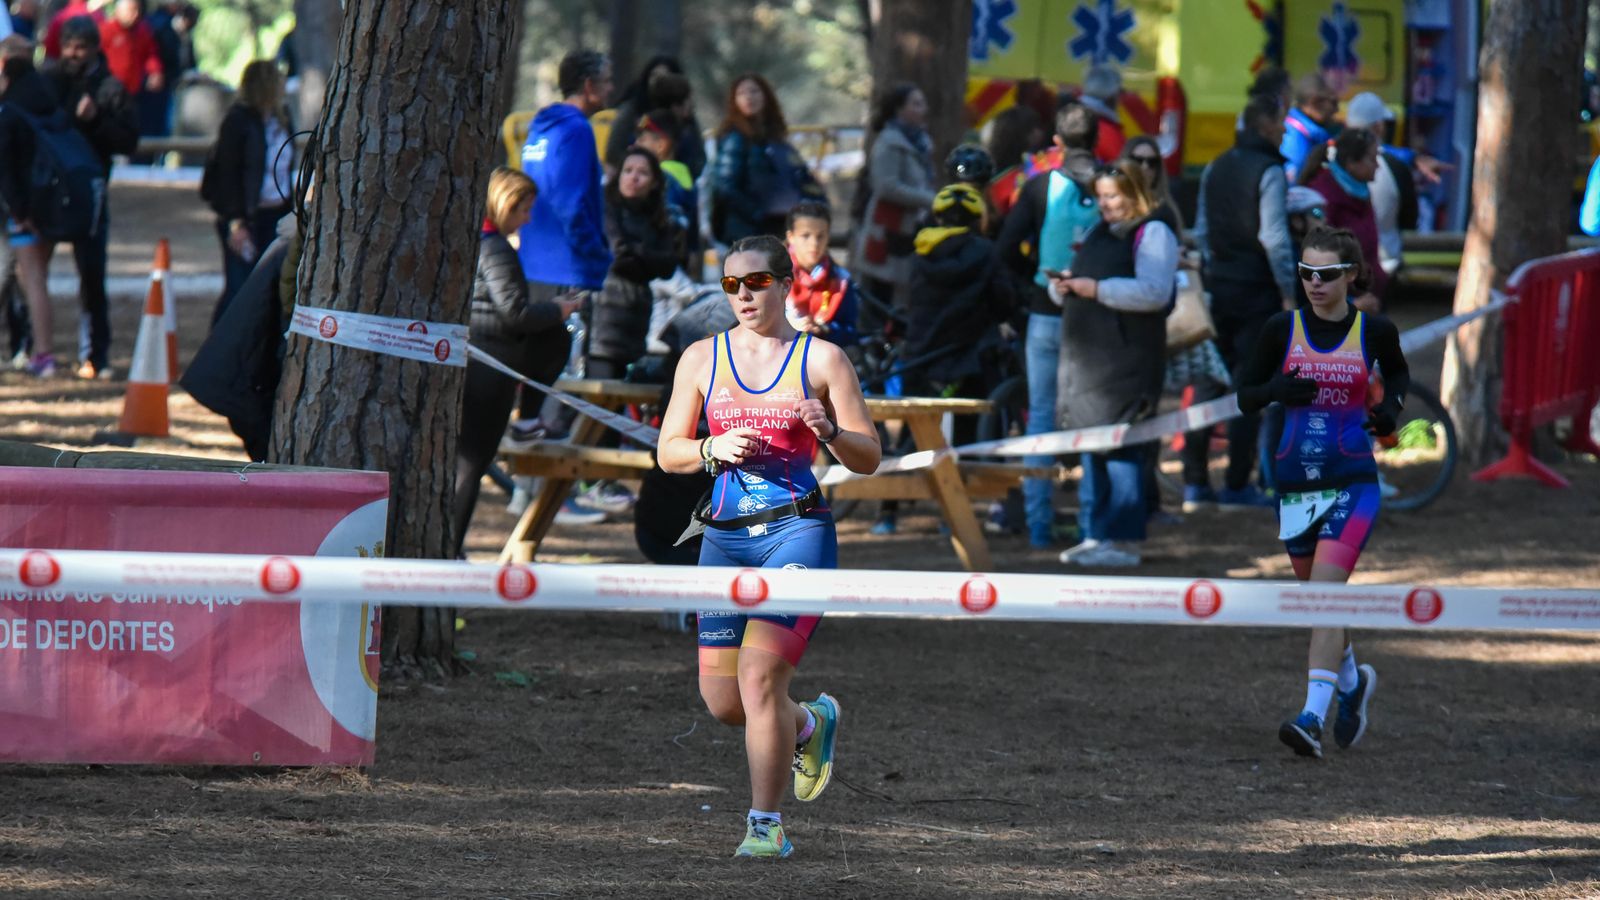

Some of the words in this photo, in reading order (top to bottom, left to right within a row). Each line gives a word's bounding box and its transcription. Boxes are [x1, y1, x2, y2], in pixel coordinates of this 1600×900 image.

[1314, 363, 1361, 374] TRIATLON
[1294, 372, 1353, 384] HICLANA
[1312, 387, 1350, 405] MPOS
[713, 408, 741, 420] CLUB
[744, 408, 800, 419] TRIATLON
[721, 419, 790, 430] CHICLANA
[36, 619, 175, 651] DEPORTES
